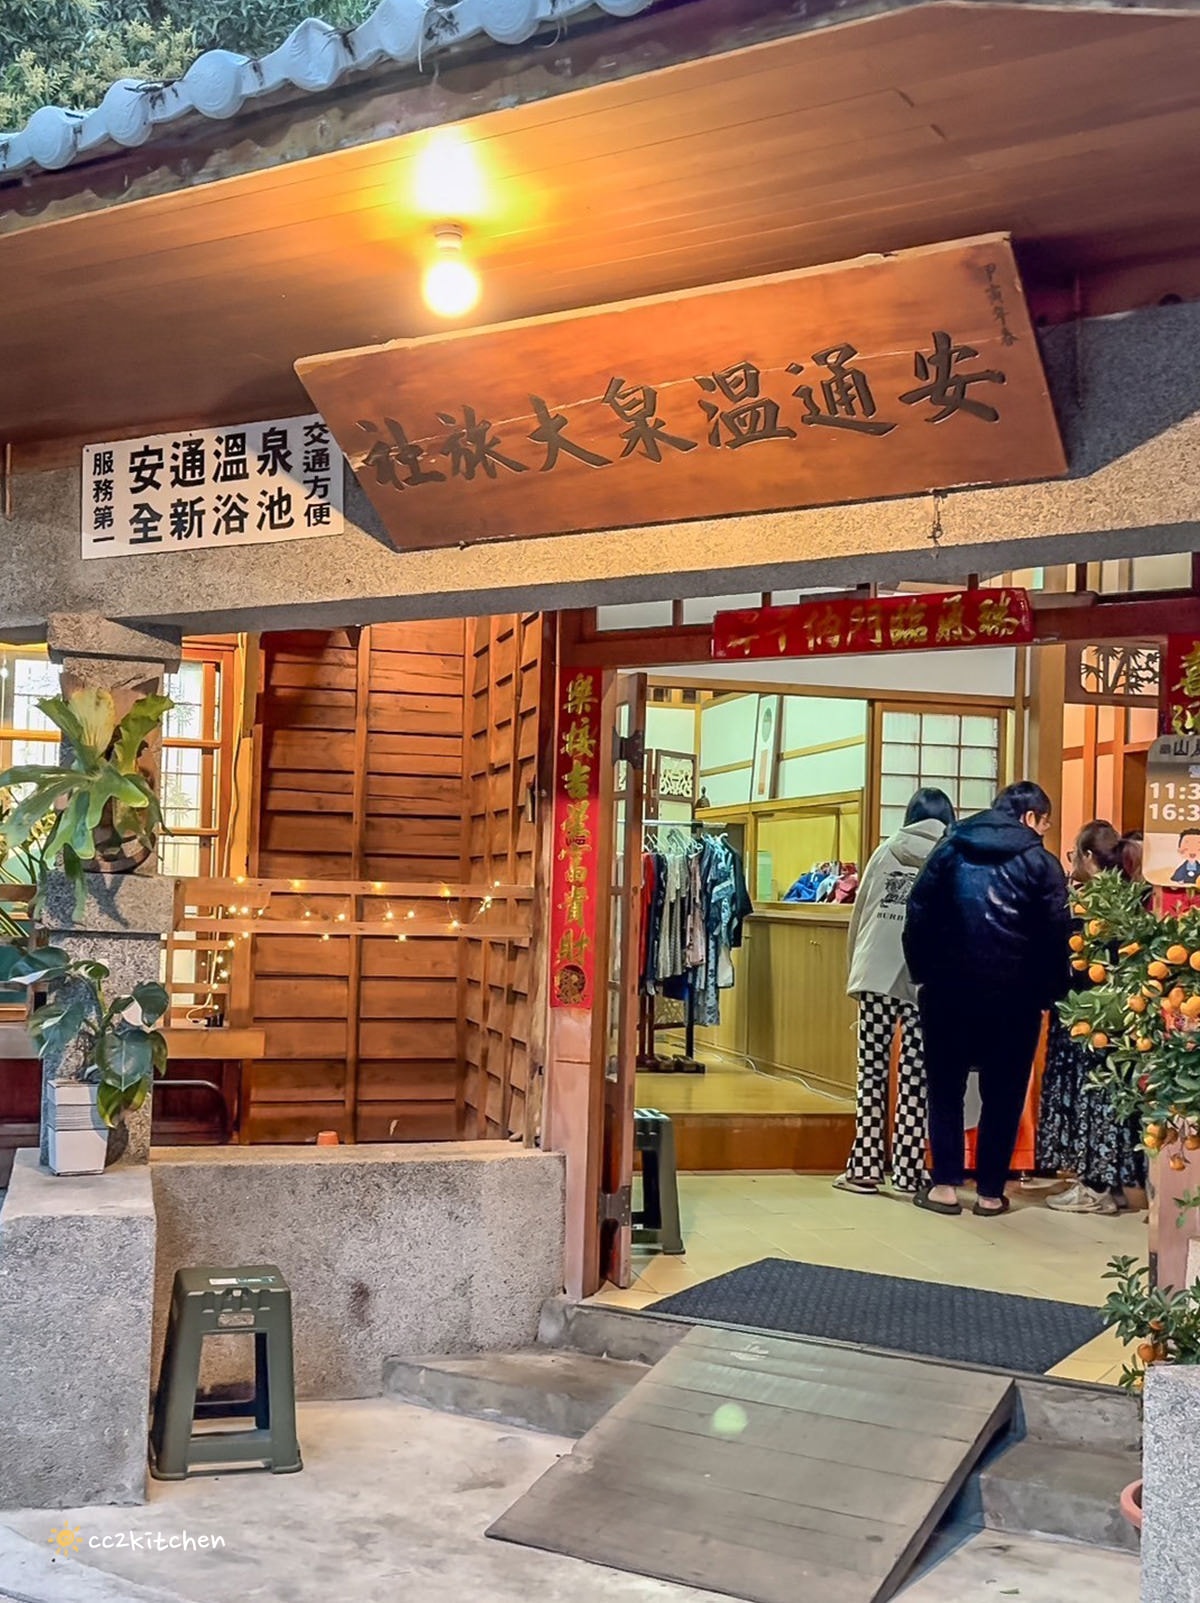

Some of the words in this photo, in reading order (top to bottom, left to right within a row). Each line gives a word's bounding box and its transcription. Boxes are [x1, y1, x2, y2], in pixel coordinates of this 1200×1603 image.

[92, 450, 115, 543] 服務第一
[128, 426, 293, 494] 安通溫泉
[302, 421, 332, 528] 交通方便
[128, 486, 295, 545] 全新浴池
